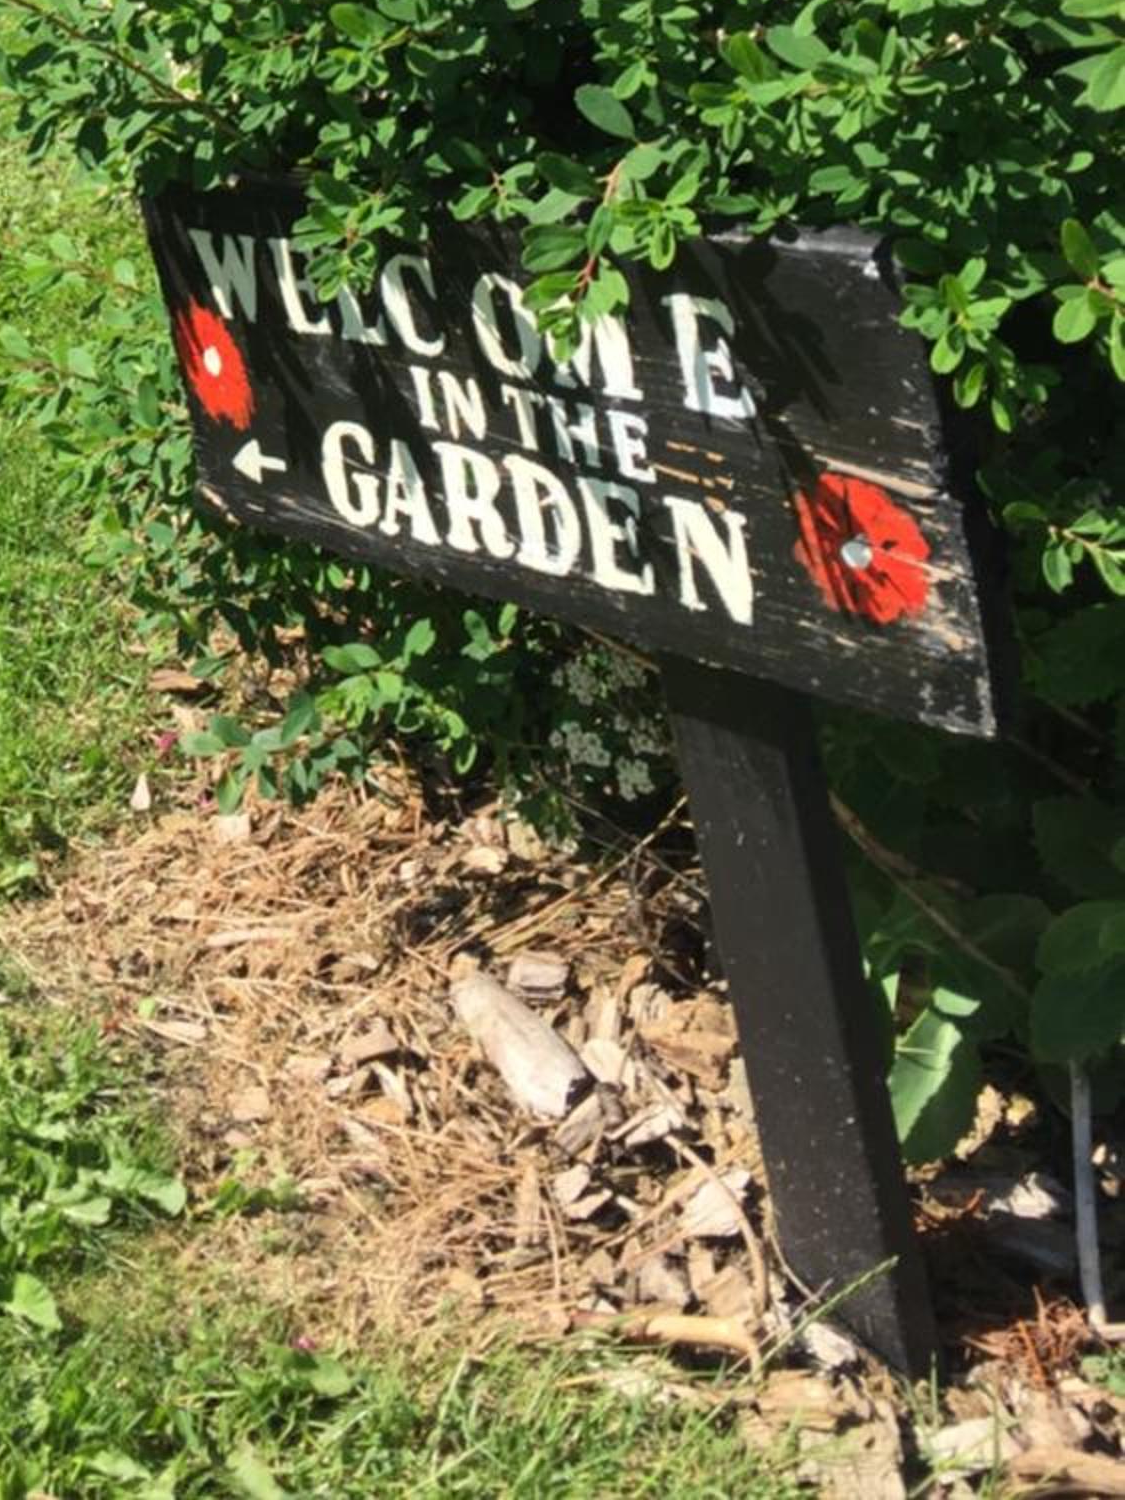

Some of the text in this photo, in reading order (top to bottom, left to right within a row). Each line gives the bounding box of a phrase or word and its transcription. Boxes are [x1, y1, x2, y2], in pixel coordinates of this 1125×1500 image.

[409, 365, 657, 483] IN THE
[321, 420, 753, 627] GARDEN
